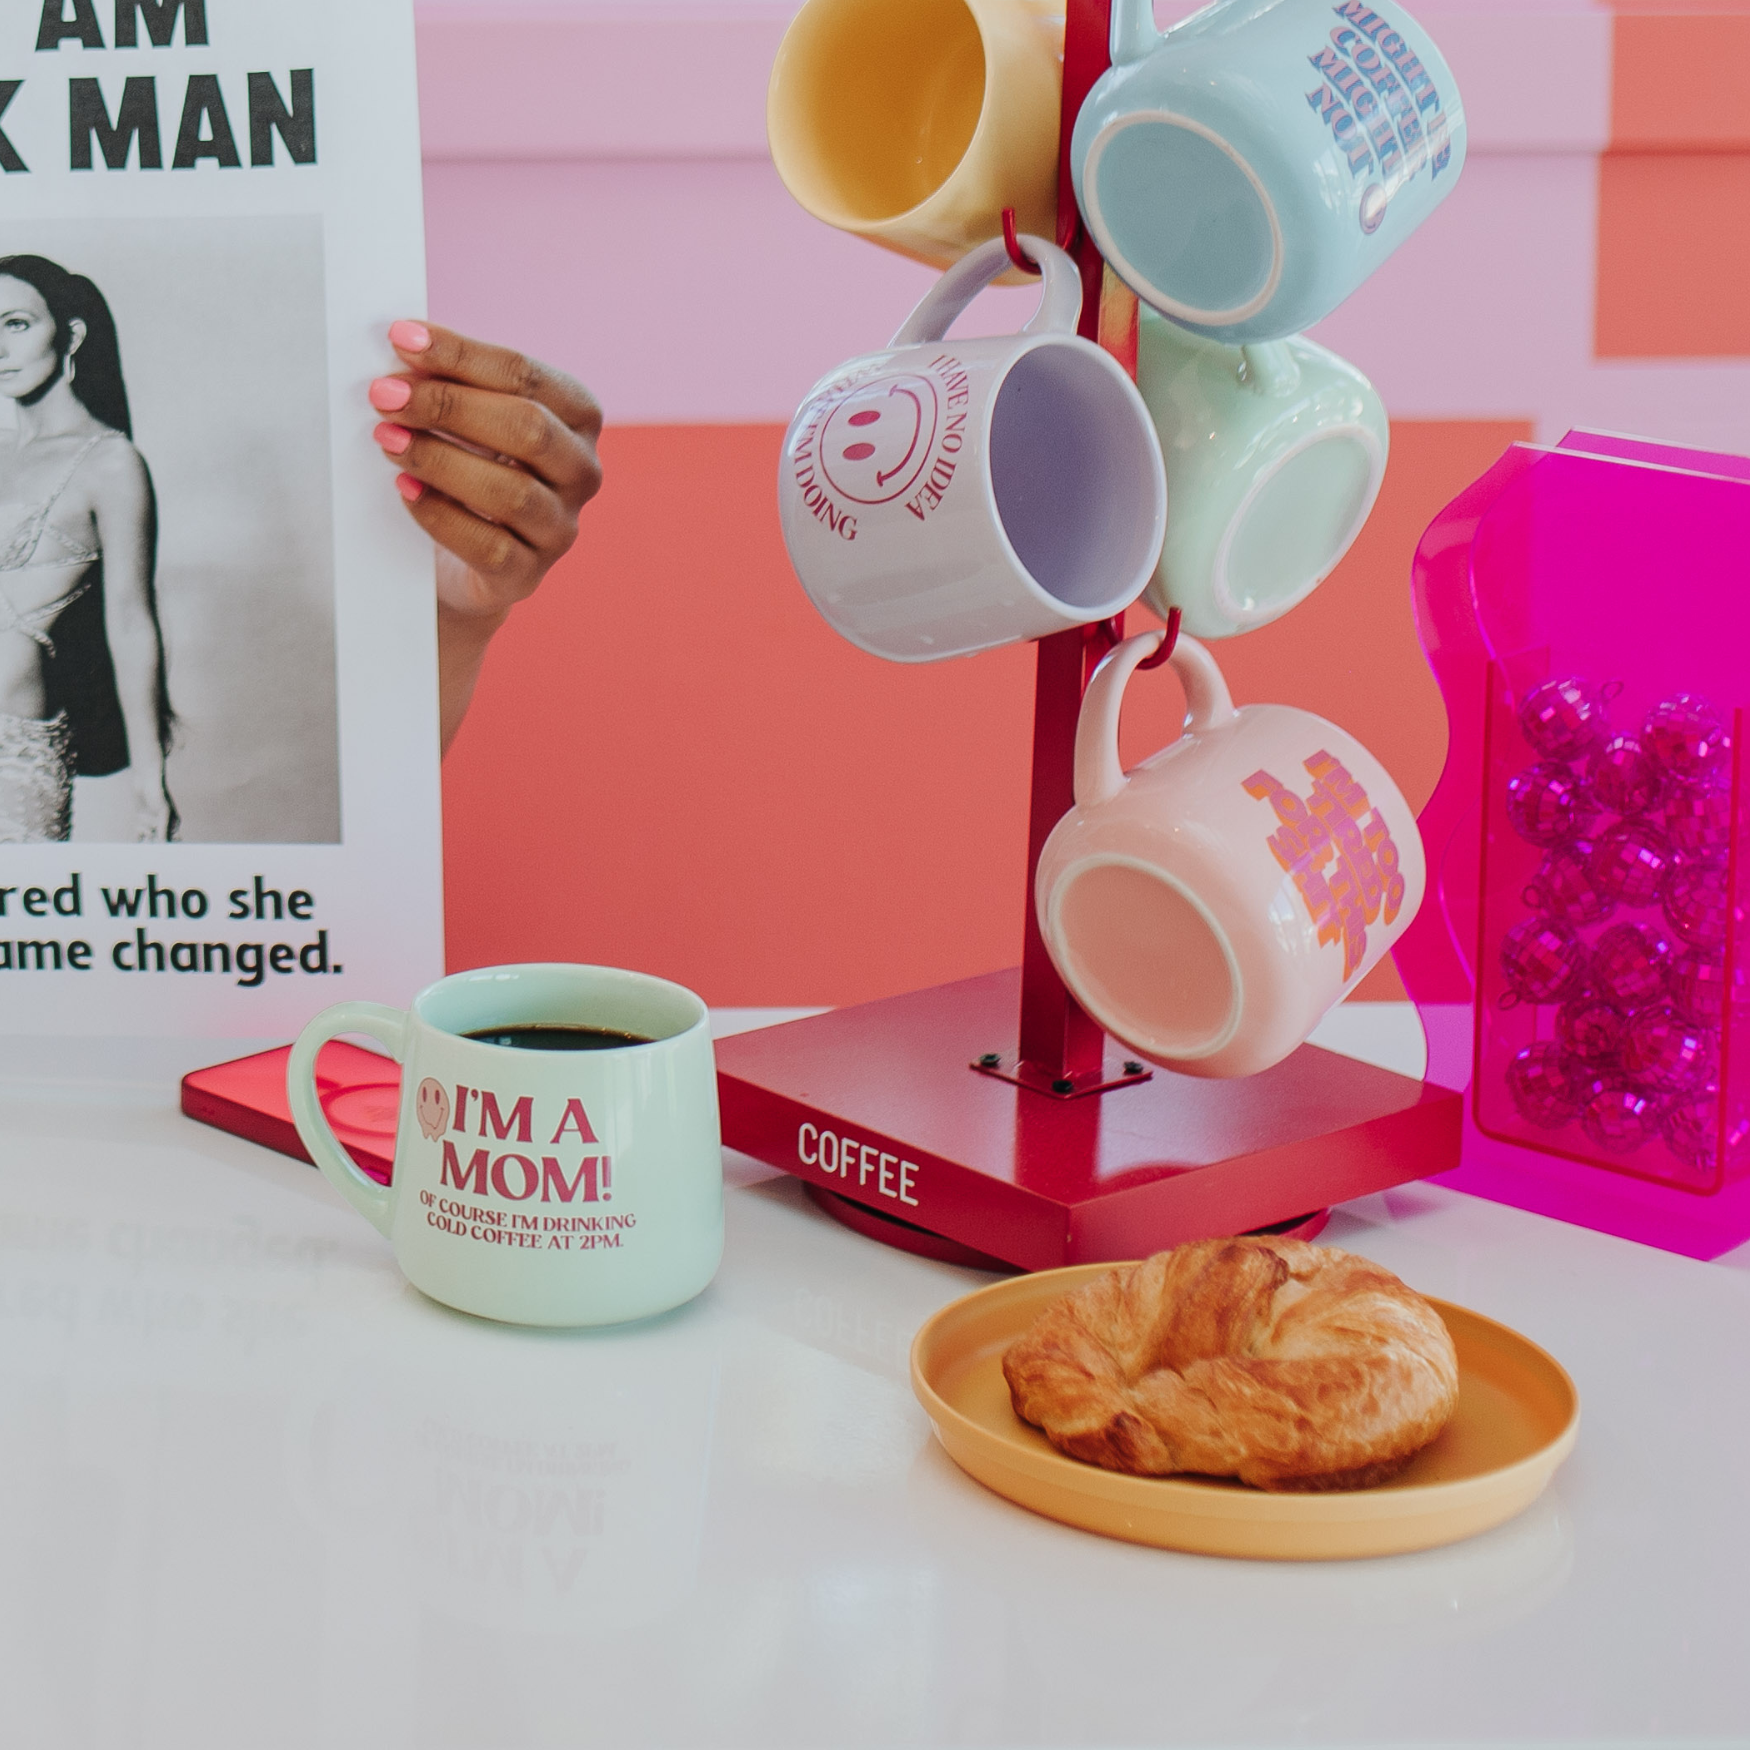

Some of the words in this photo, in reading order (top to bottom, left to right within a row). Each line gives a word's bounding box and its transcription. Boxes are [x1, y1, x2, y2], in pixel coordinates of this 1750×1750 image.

[67, 68, 319, 172] MAN
[1305, 82, 1374, 180] NOT
[1307, 45, 1400, 180] MIGHT
[929, 354, 946, 368] I
[936, 357, 969, 410] HAVE
[941, 411, 968, 454] NO
[796, 464, 858, 540] DOING
[905, 456, 957, 521] IDEA
[1241, 769, 1334, 872] FOR
[1303, 749, 1370, 820] I'M
[1364, 807, 1406, 927] TOO
[1306, 779, 1385, 926] TIRED
[101, 875, 209, 921] who
[227, 875, 316, 922] she
[1266, 826, 1343, 949] SHIT
[111, 928, 344, 988] changed.
[452, 1084, 534, 1143] I'M
[549, 1098, 599, 1144] A
[440, 1139, 612, 1203] MOM!
[798, 1122, 920, 1207] COFFEE
[420, 1190, 436, 1208] OF
[439, 1199, 508, 1228] COURSE
[511, 1213, 539, 1231] I'M
[543, 1213, 637, 1232] DRINKING
[427, 1211, 467, 1236] COLD
[471, 1225, 542, 1249] COFFEE
[547, 1235, 574, 1250] AT
[579, 1233, 625, 1250] 2PM.
